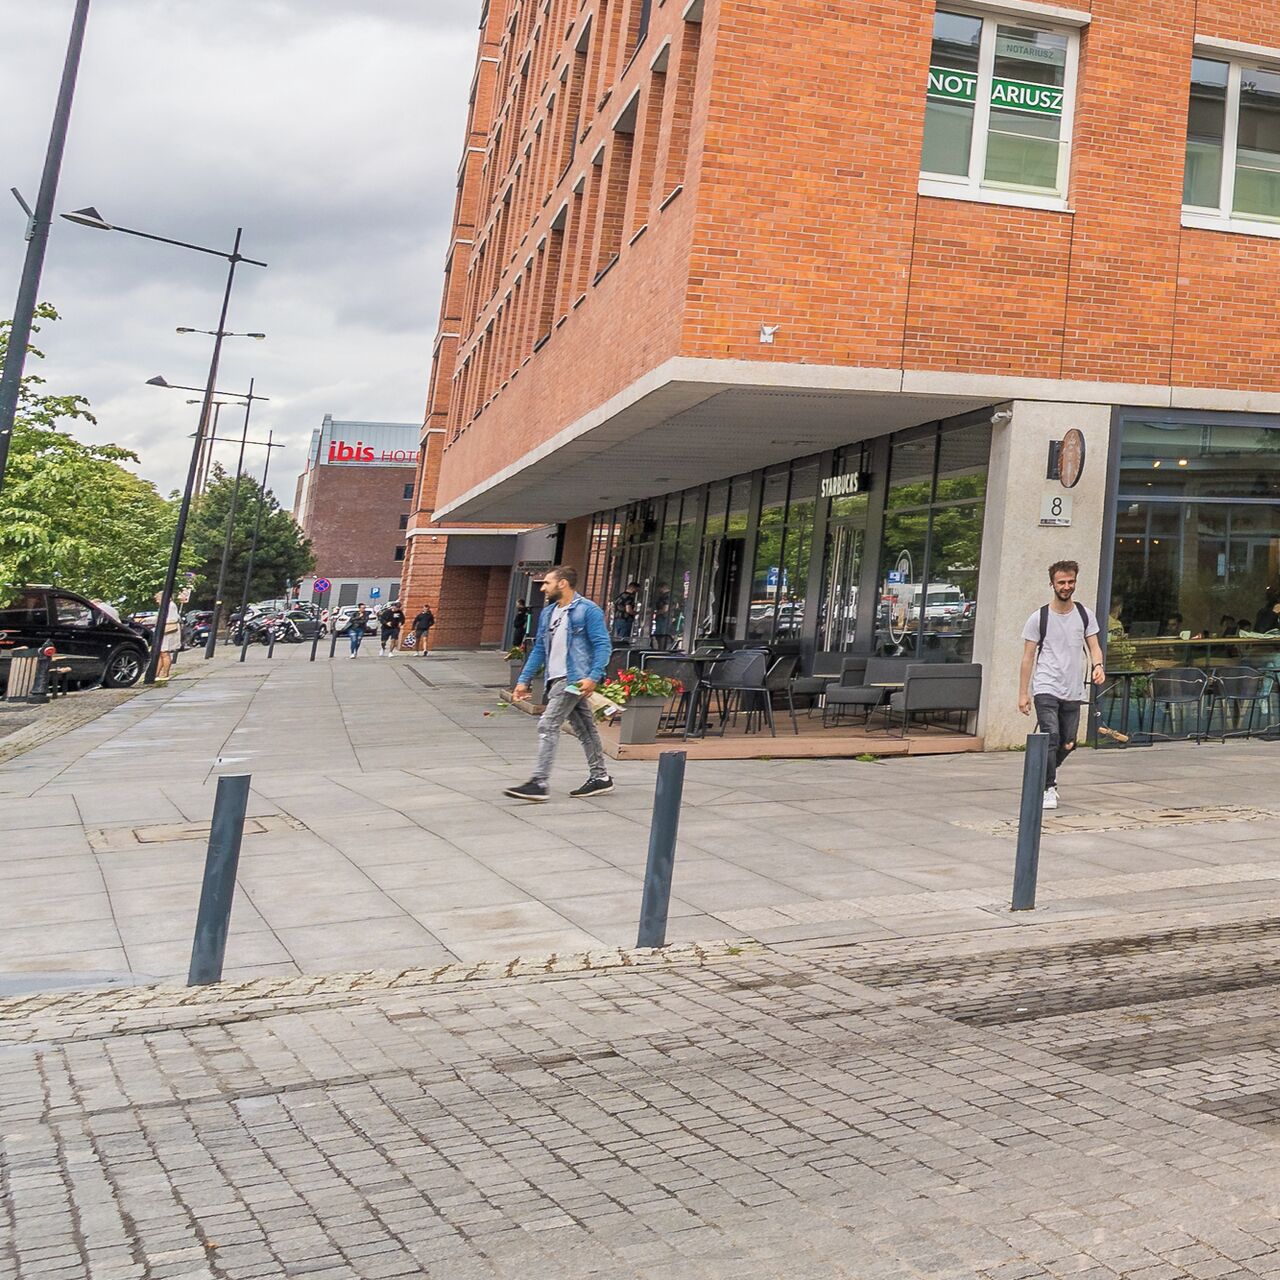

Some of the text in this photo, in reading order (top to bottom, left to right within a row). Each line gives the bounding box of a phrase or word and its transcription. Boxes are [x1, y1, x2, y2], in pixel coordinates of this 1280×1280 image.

[1006, 44, 1054, 60] NOTARIUSZ
[328, 440, 375, 463] ibis
[821, 472, 859, 498] STARBUCKS
[1051, 497, 1062, 516] 8
